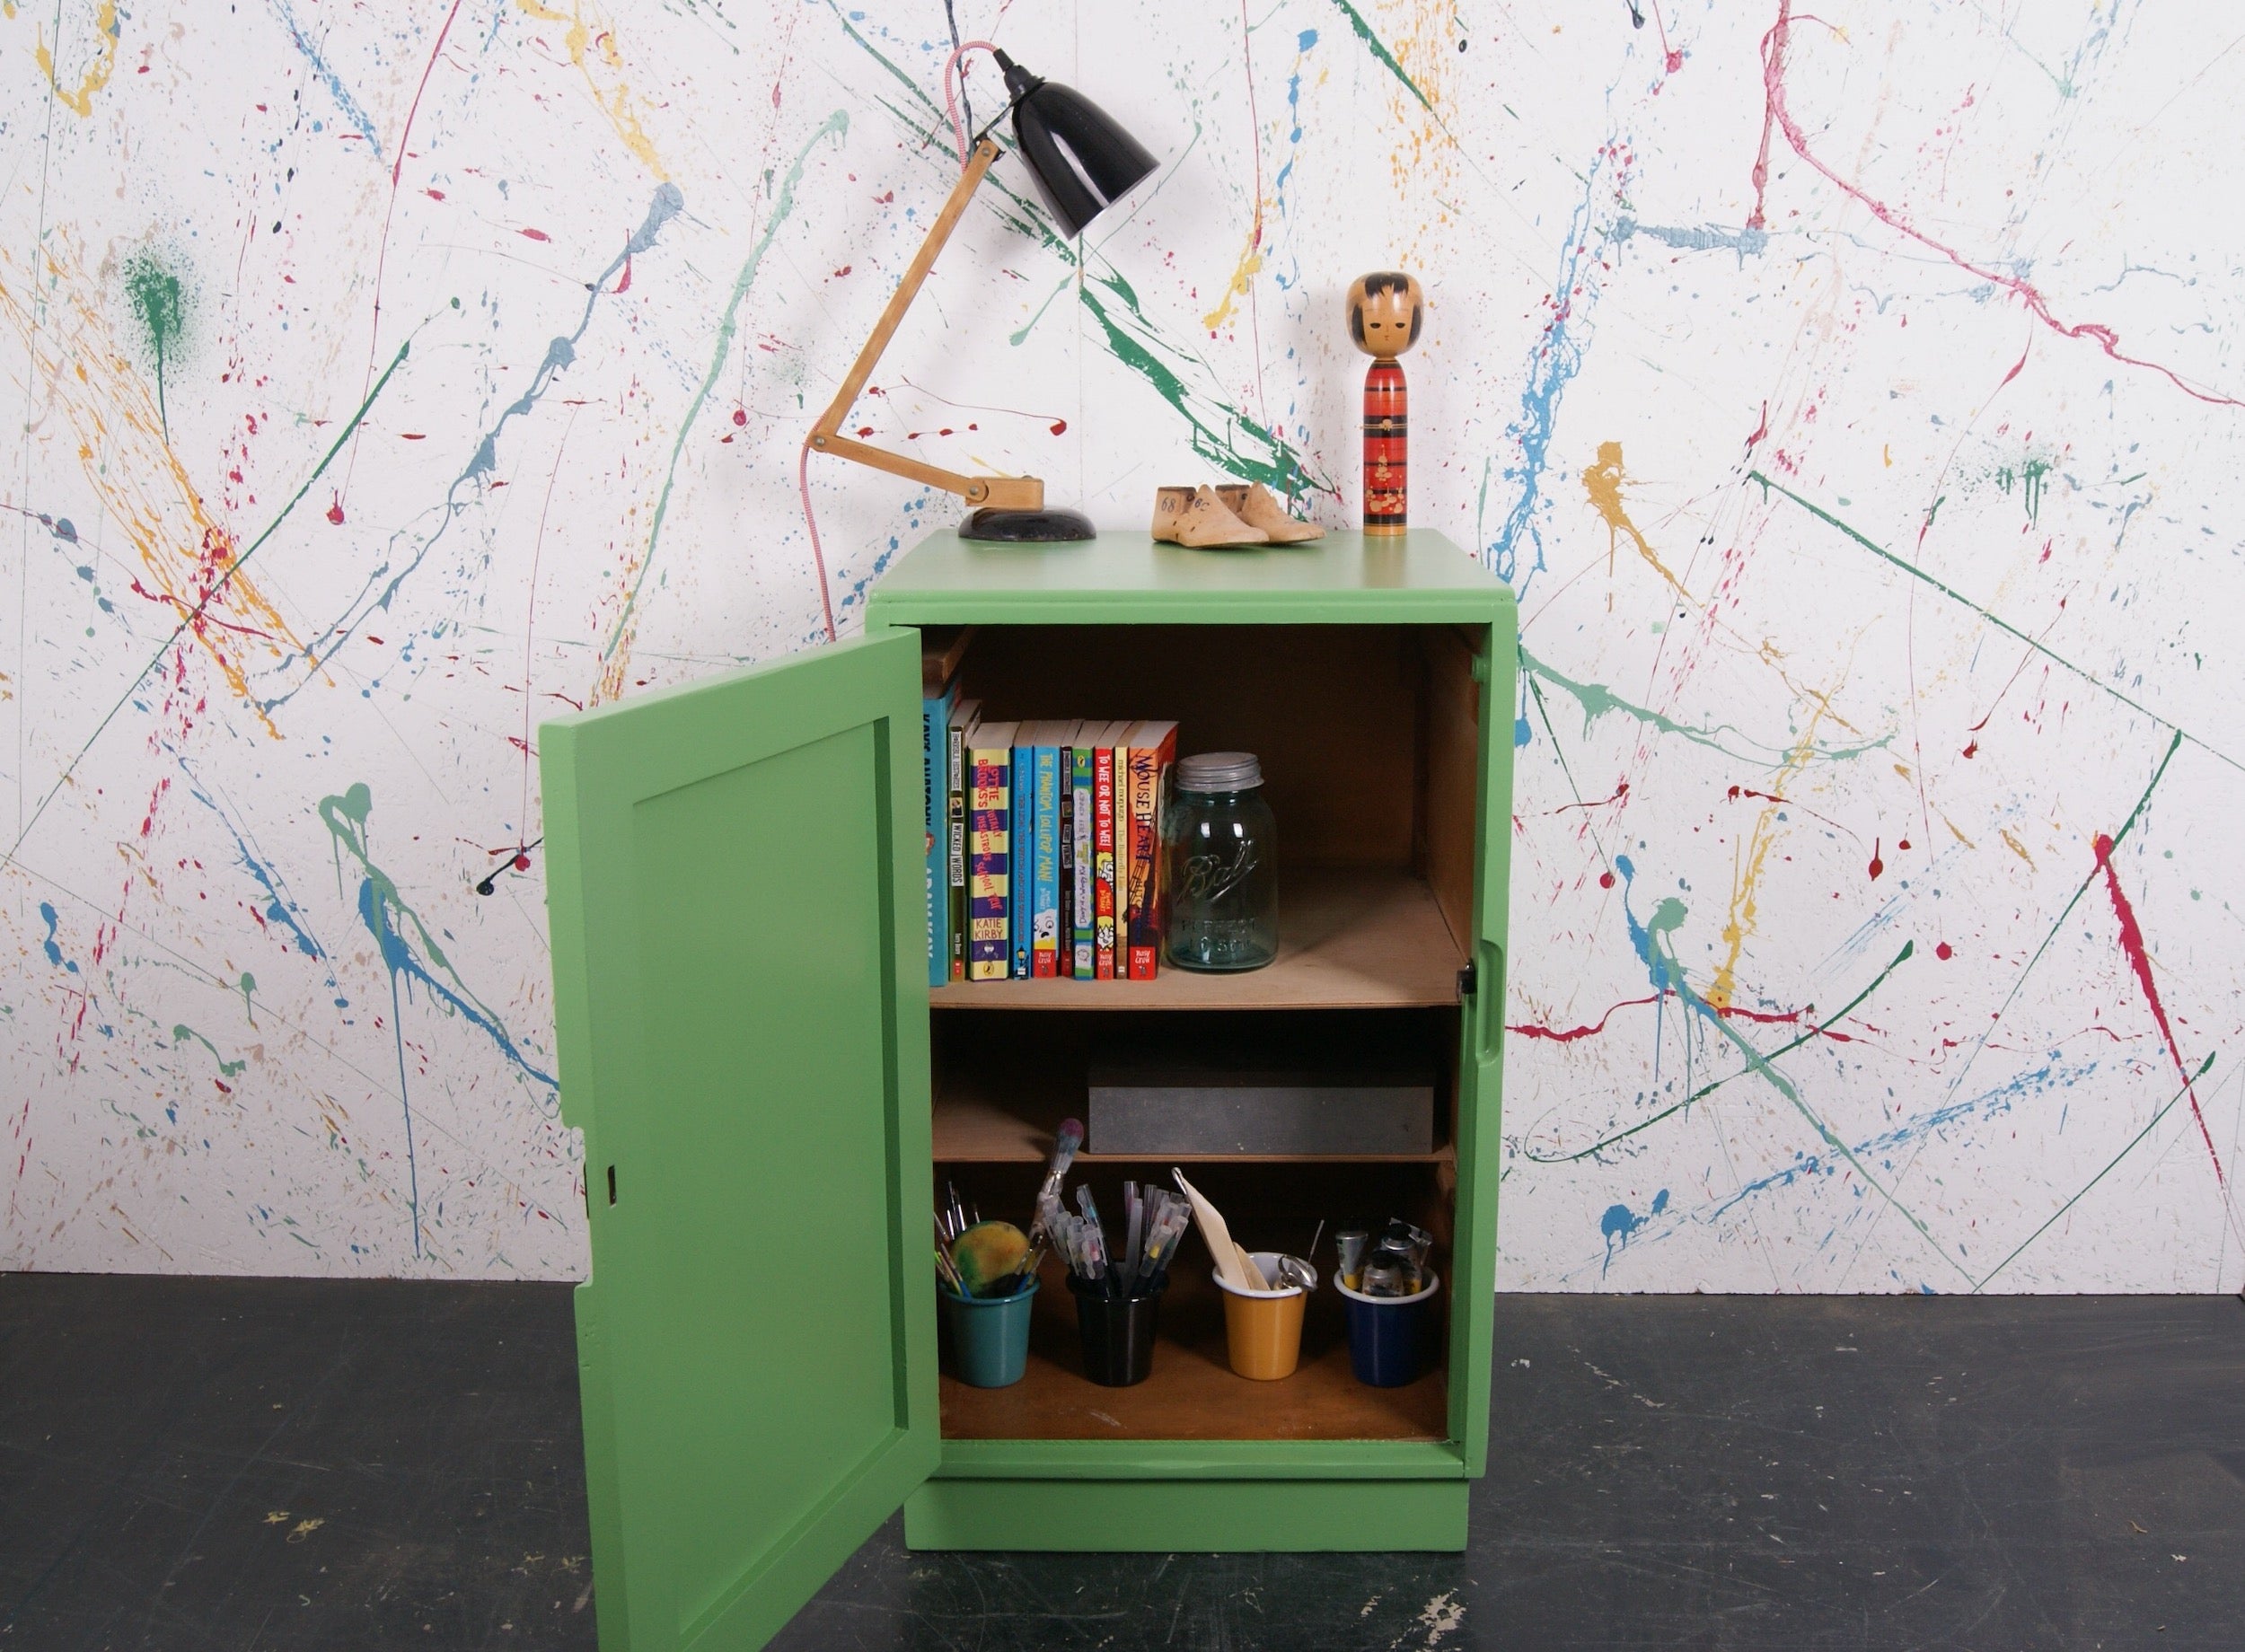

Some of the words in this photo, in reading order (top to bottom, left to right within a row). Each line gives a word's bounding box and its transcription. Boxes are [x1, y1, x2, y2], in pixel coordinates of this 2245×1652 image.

[1161, 496, 1176, 513] 68
[1039, 754, 1053, 768] THE
[977, 759, 989, 808] BROOKS'S
[988, 765, 999, 801] LOTTIE
[1098, 766, 1111, 783] WEE
[1039, 771, 1054, 812] PHANTOM
[1098, 785, 1111, 797] OR
[1098, 799, 1111, 816] NOT
[952, 824, 962, 851] WICKED
[987, 810, 1002, 839] TOTALLY
[1039, 814, 1053, 854] LOLLIPOP
[977, 815, 991, 862] DISASTROUS
[1099, 829, 1112, 847] WEE!
[952, 857, 962, 883] WORDS
[976, 862, 994, 892] SCHOOL
[1037, 856, 1054, 882] MAN!
[975, 929, 1003, 940] KIRBY
[976, 918, 1001, 928] KATIE
